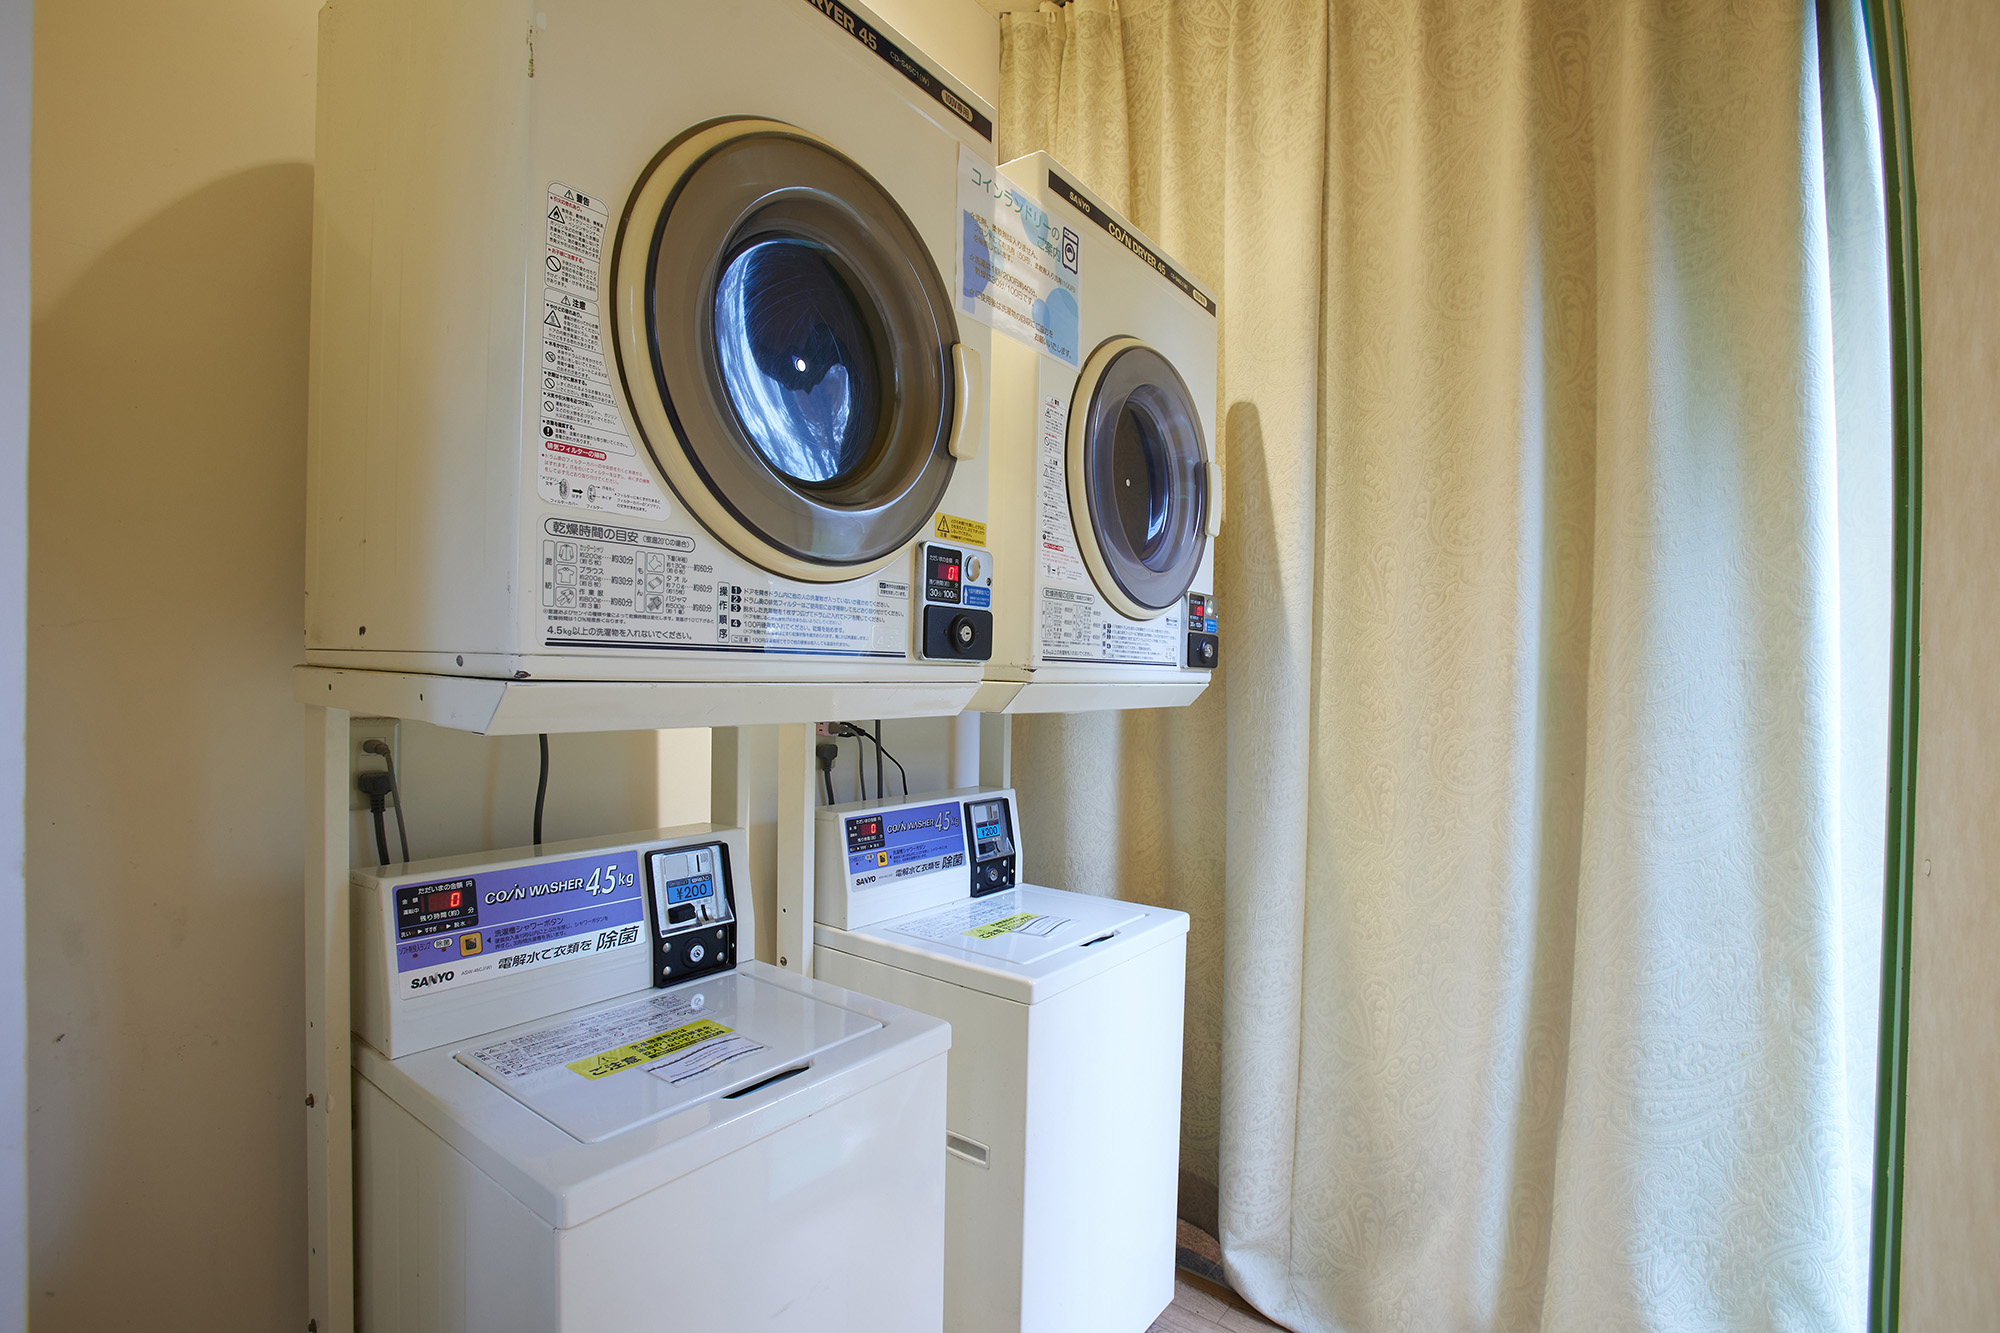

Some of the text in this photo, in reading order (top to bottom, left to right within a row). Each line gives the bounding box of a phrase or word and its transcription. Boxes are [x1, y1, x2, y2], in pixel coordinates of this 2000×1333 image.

[858, 27, 878, 51] 45
[576, 193, 590, 207] 警告
[971, 167, 1060, 241] コインランドリーの
[1069, 191, 1091, 213] SANYO
[1036, 235, 1061, 263] ご案内
[1108, 222, 1166, 276] COIN DRYER 45
[572, 298, 586, 310] 注意
[547, 443, 605, 460] 排気フィルターの掃除
[553, 521, 638, 543] 乾燥時間の目安
[579, 567, 604, 575] ブラウス
[666, 575, 688, 583] タオル
[947, 566, 954, 580] 0
[929, 588, 942, 597] 30分
[719, 586, 728, 638] 操作順序
[547, 625, 692, 640] 4.5kg以上の洗濯物を入れないでください。
[871, 823, 876, 834] 0
[907, 818, 935, 831] WASHER
[951, 817, 959, 827] kg
[942, 853, 963, 870] 除菌
[418, 882, 463, 895] ただいまの金額
[484, 884, 526, 906] COIN
[529, 877, 584, 899] WASHER
[618, 872, 635, 887] kg
[856, 875, 876, 886] SANYO
[450, 892, 460, 907] 0
[676, 883, 707, 900] ¥200
[494, 917, 564, 937] 洗濯槽シャワーボタン
[498, 925, 640, 970] 電解水で衣類を 除菌
[410, 971, 455, 989] SANYO
[588, 1055, 642, 1076] ご注意
